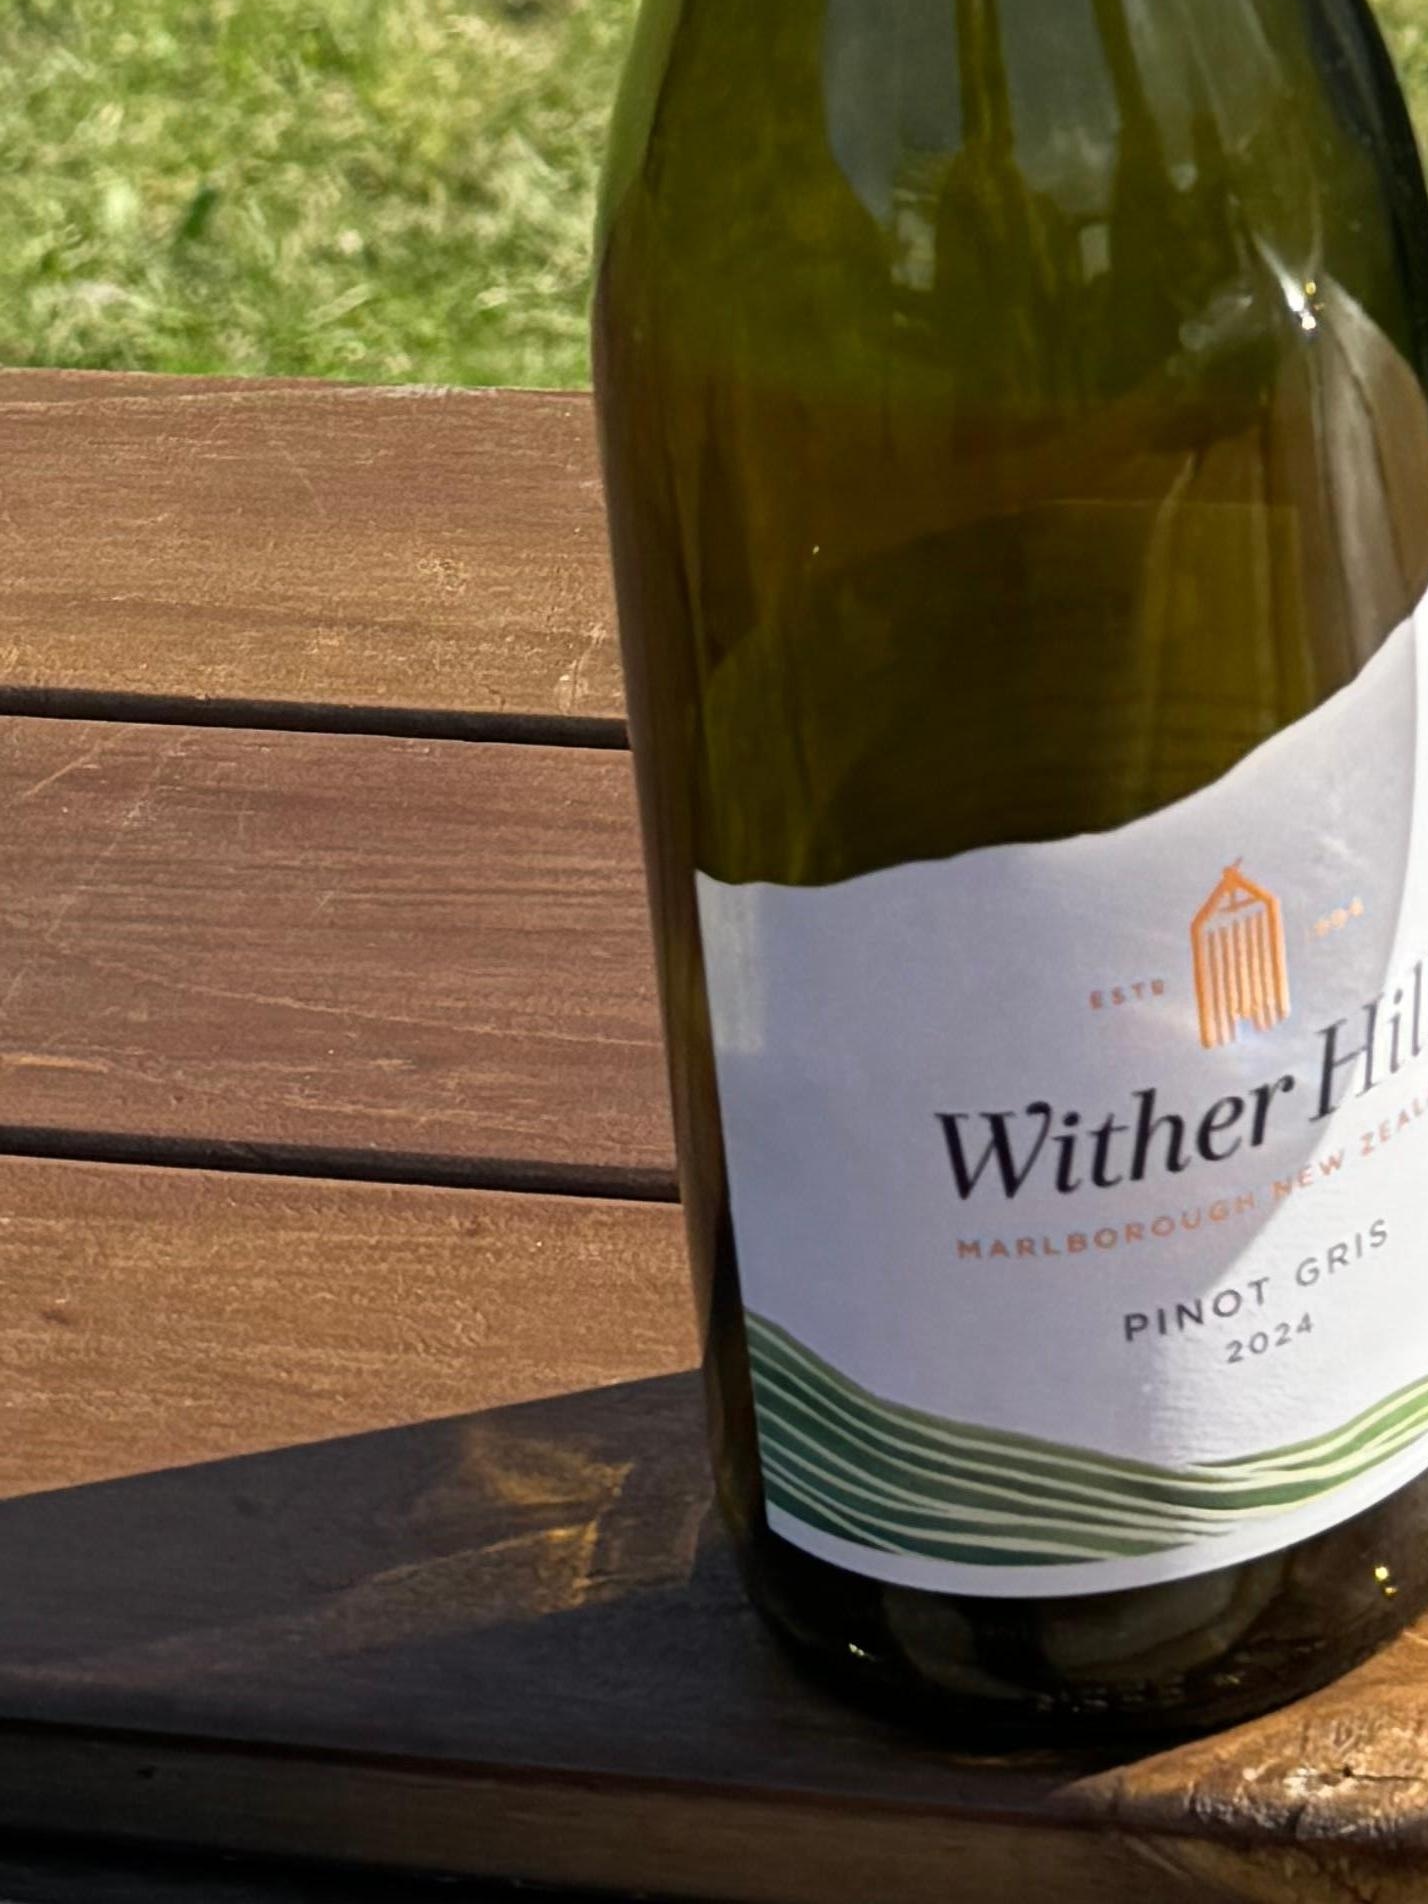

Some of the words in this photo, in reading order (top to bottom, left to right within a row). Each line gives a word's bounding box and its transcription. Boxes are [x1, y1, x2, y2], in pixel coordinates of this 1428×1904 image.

[933, 1074, 1296, 1200] Wither
[957, 1193, 1255, 1258] MARLBOROUGH
[1270, 1150, 1344, 1199] NEW
[1124, 1277, 1270, 1341] PINOT
[1295, 1219, 1388, 1286] GRIS
[1225, 1312, 1313, 1363] 2024
